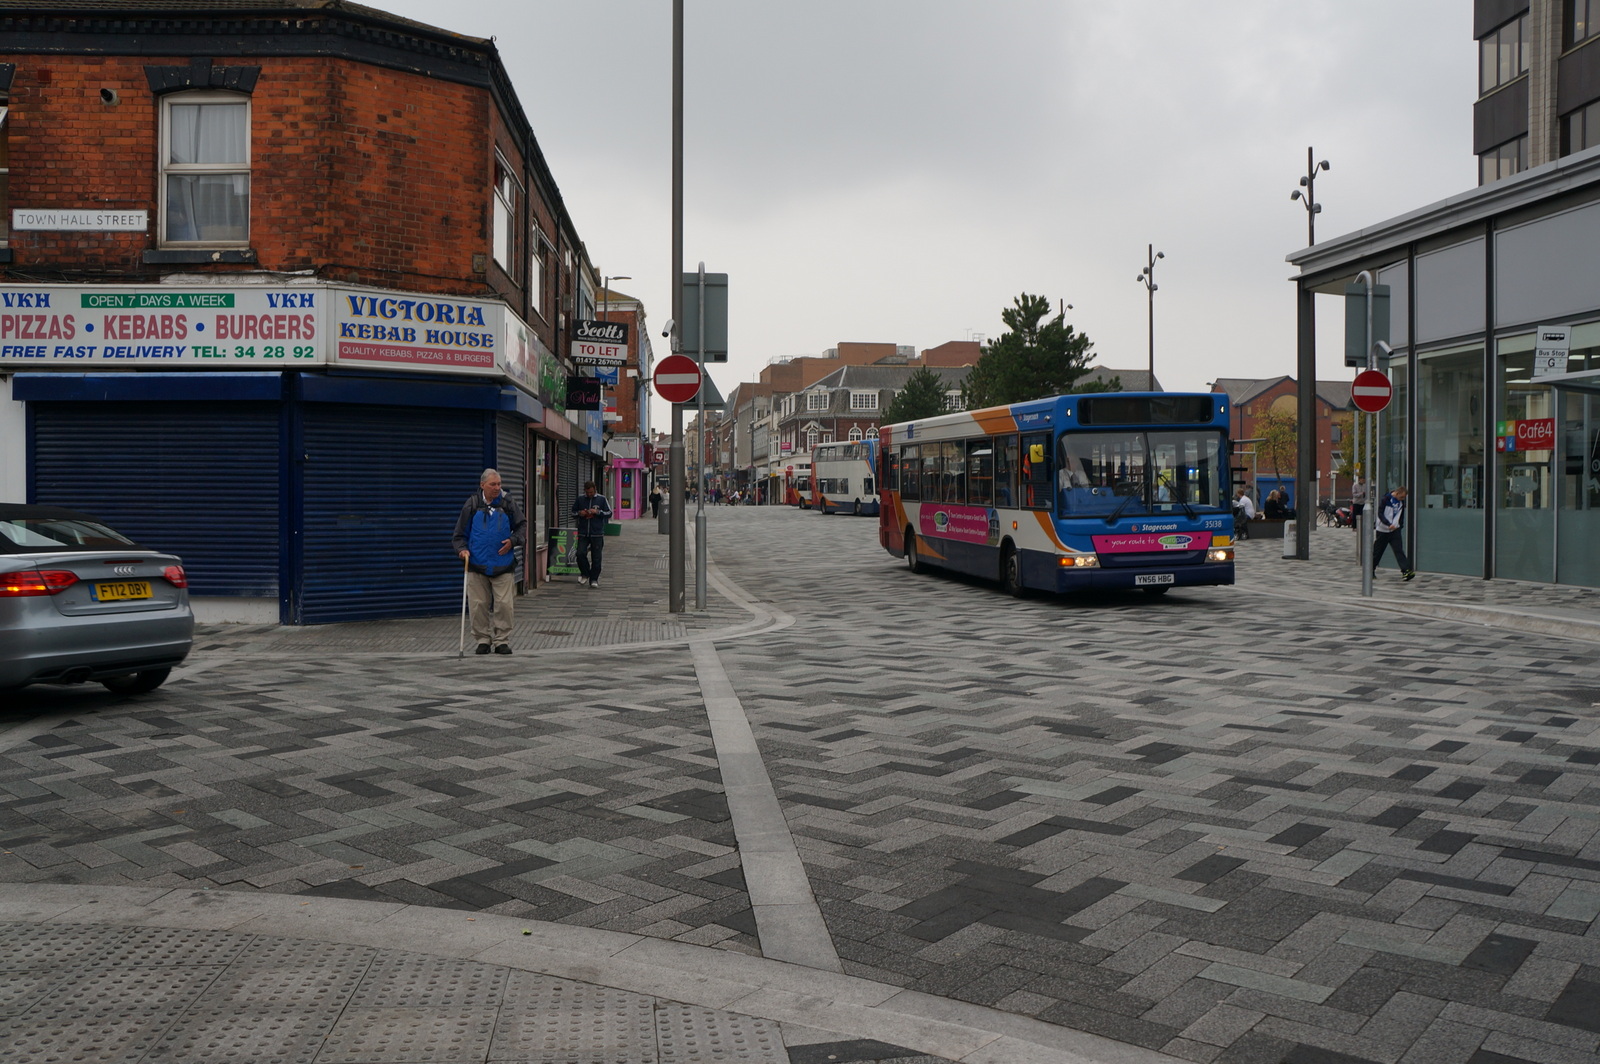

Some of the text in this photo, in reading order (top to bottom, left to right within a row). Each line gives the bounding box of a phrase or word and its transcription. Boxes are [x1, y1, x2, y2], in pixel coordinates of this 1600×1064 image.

[19, 214, 143, 226] TOWN HALL STREET
[1, 292, 51, 308] VKH
[88, 295, 227, 307] OPEN 7 DAYS A WEEK
[266, 292, 315, 308] VKH
[345, 294, 486, 328] VICTORIA
[1, 313, 315, 340] PIZZAS KEBABS BURGERS
[576, 320, 624, 340] Scotts
[338, 321, 494, 349] KEBAB HOUSE
[1, 345, 315, 358] FREE FAST DELIVERY TEL: 34 28 92
[341, 345, 377, 356] QUALITY
[379, 348, 414, 359] KEBABS,
[416, 351, 444, 361] PIZZAS
[454, 353, 491, 364] BURGERS
[579, 344, 620, 357] TO LET
[1551, 349, 1566, 357] Stop
[1547, 358, 1556, 368] G
[570, 390, 599, 405] Nails
[1518, 421, 1553, 439] Café4
[1141, 523, 1178, 533] Stagecoach
[1205, 520, 1223, 529] 35138
[551, 530, 567, 566] nails
[1111, 540, 1126, 548] your
[1128, 537, 1146, 545] route
[1147, 536, 1155, 544] to
[1138, 574, 1172, 583] YN56 HBG
[99, 583, 148, 597] FT12 DBY
